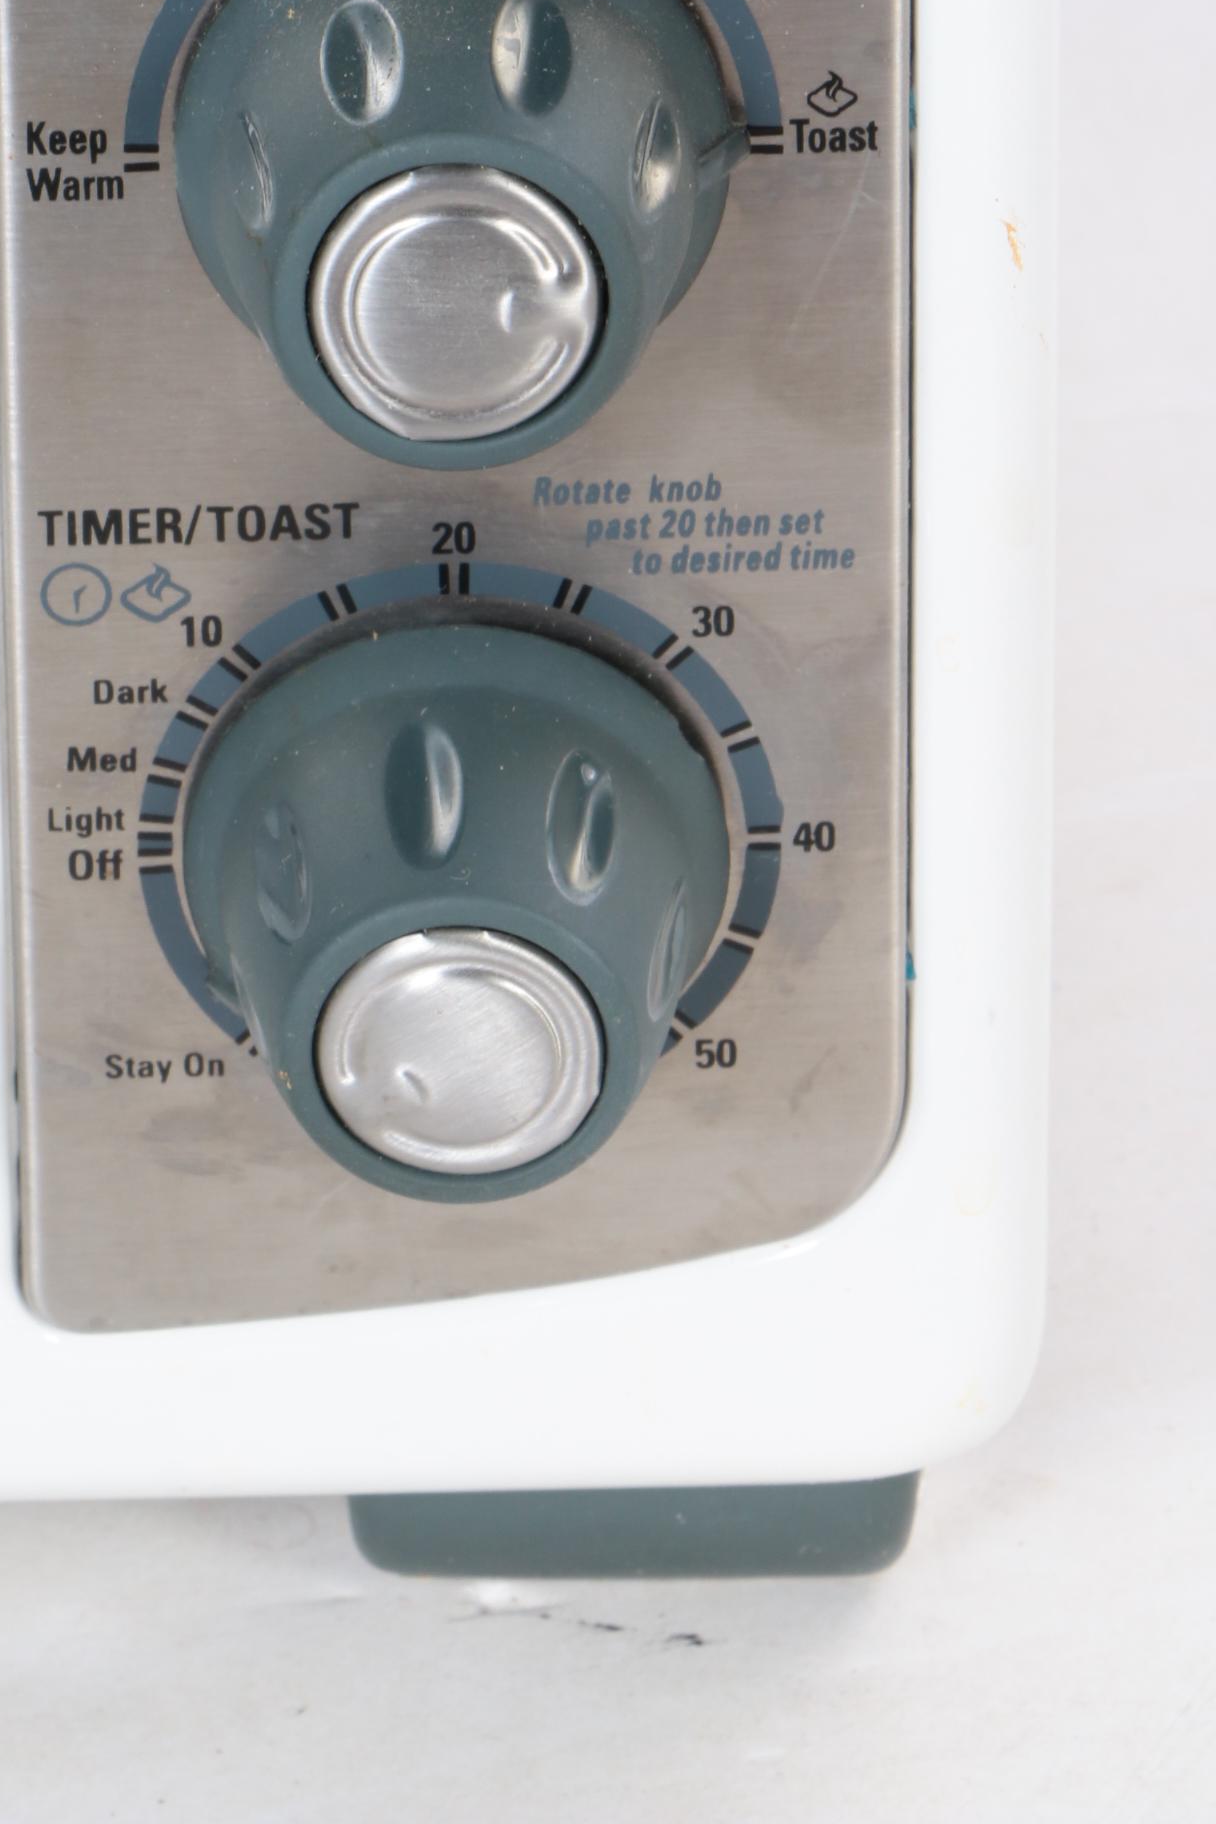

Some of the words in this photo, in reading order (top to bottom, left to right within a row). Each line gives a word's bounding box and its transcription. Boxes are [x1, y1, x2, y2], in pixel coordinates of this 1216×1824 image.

[27, 122, 107, 164] Keep
[790, 118, 877, 153] Toast
[27, 168, 124, 201] Warm
[534, 476, 630, 506] Rotate
[649, 473, 721, 502] knob
[38, 502, 360, 545] TIMER/TOAST
[432, 522, 475, 555] 20
[585, 514, 650, 546] past
[659, 509, 696, 538] 20
[705, 508, 770, 538] then
[779, 510, 824, 535] set
[634, 550, 661, 575] to
[671, 543, 782, 574] desired
[790, 540, 855, 570] time
[181, 615, 222, 647] 10
[692, 606, 734, 637] 30
[94, 679, 168, 704] Dark
[68, 747, 136, 772] Med
[48, 807, 124, 838] Light
[793, 821, 835, 852] 40
[69, 850, 122, 880] Off
[105, 1054, 171, 1083] Stay
[184, 1052, 224, 1076] On
[695, 1039, 737, 1068] 50
